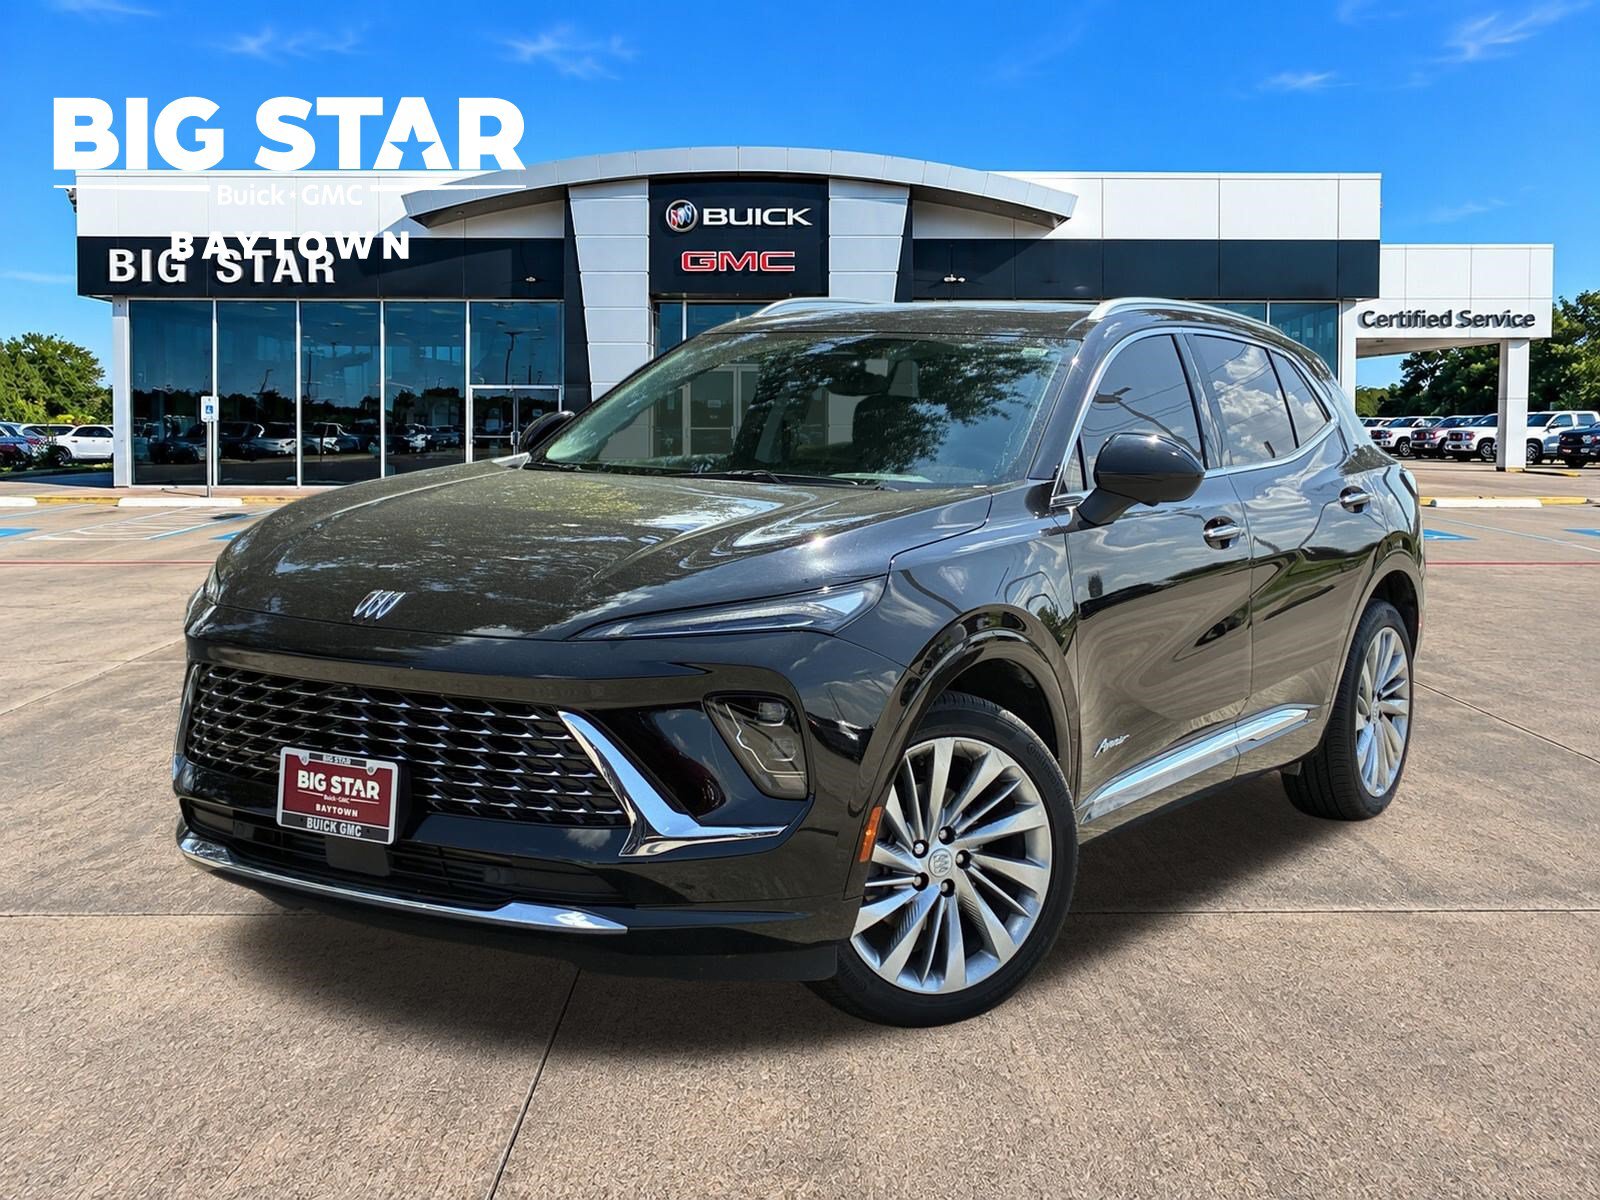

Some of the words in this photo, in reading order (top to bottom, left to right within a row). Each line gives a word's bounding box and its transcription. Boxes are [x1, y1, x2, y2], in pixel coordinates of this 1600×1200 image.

[703, 207, 813, 226] BUICK
[108, 248, 188, 284] BIG
[216, 248, 336, 284] STAR
[681, 250, 796, 272] GMC
[1358, 309, 1453, 329] Certified
[1456, 309, 1536, 329] Service
[297, 769, 327, 792] BIG
[330, 775, 380, 800] STAR
[315, 803, 358, 817] BAYTOWN
[306, 816, 337, 833] BUICK
[339, 822, 362, 837] GMC
